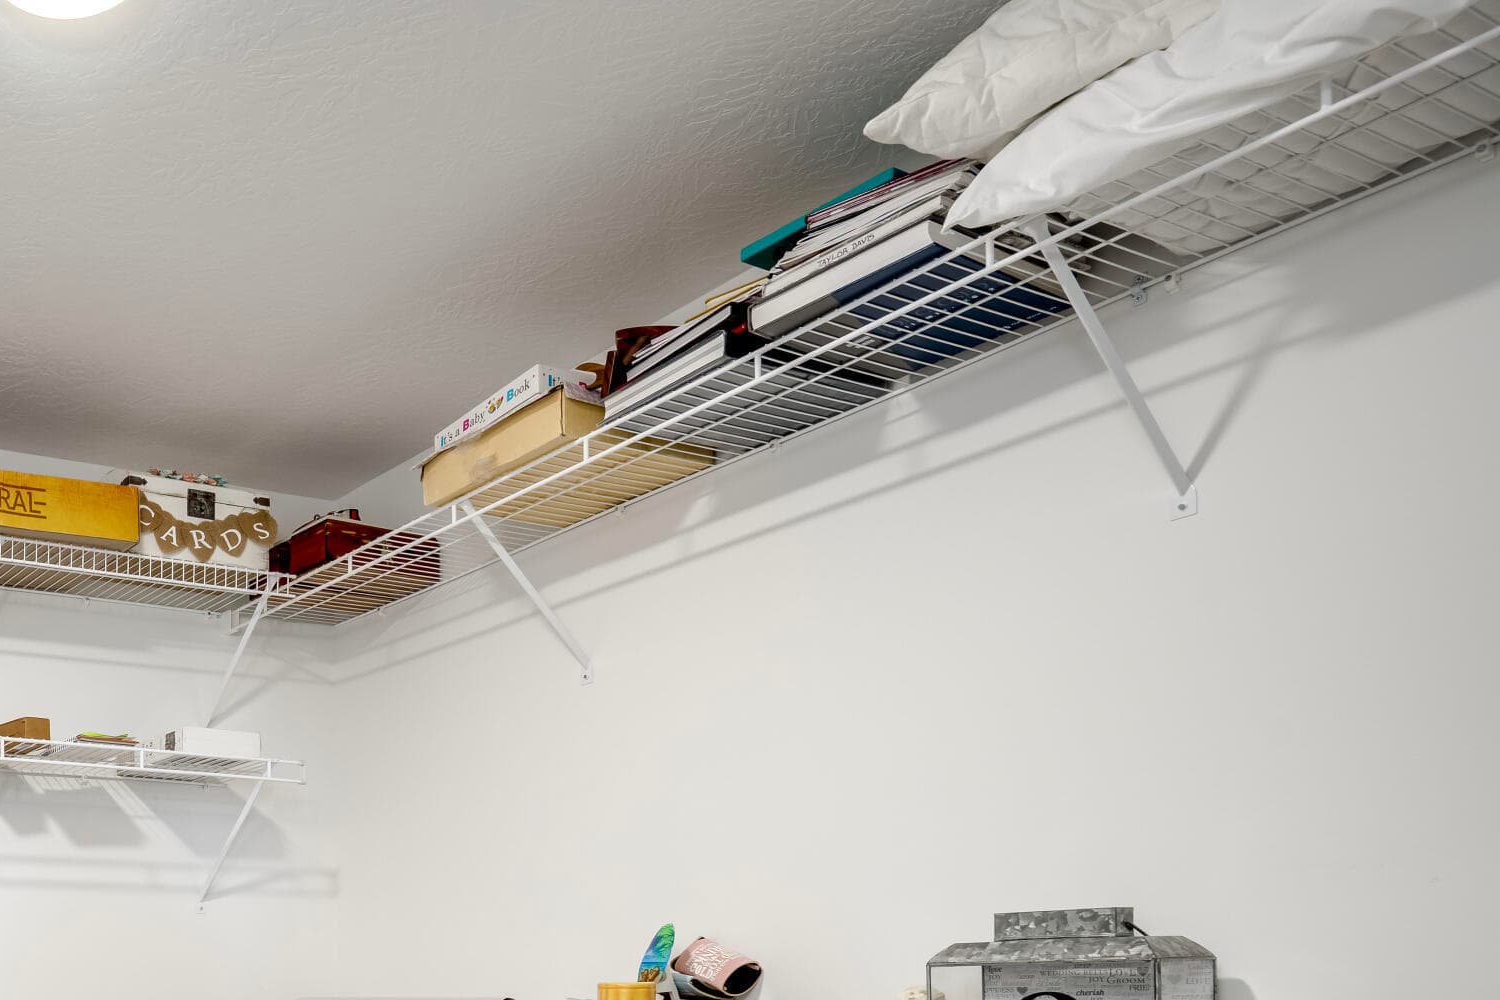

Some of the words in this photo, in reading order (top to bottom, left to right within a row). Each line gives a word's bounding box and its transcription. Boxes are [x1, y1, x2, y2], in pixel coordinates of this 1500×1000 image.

[817, 247, 848, 266] TAYLOR
[852, 234, 875, 250] DAVIS
[440, 431, 453, 447] It's
[454, 427, 461, 438] a
[462, 410, 486, 432] Baby
[506, 379, 531, 402] Book
[1075, 988, 1105, 996] cherish
